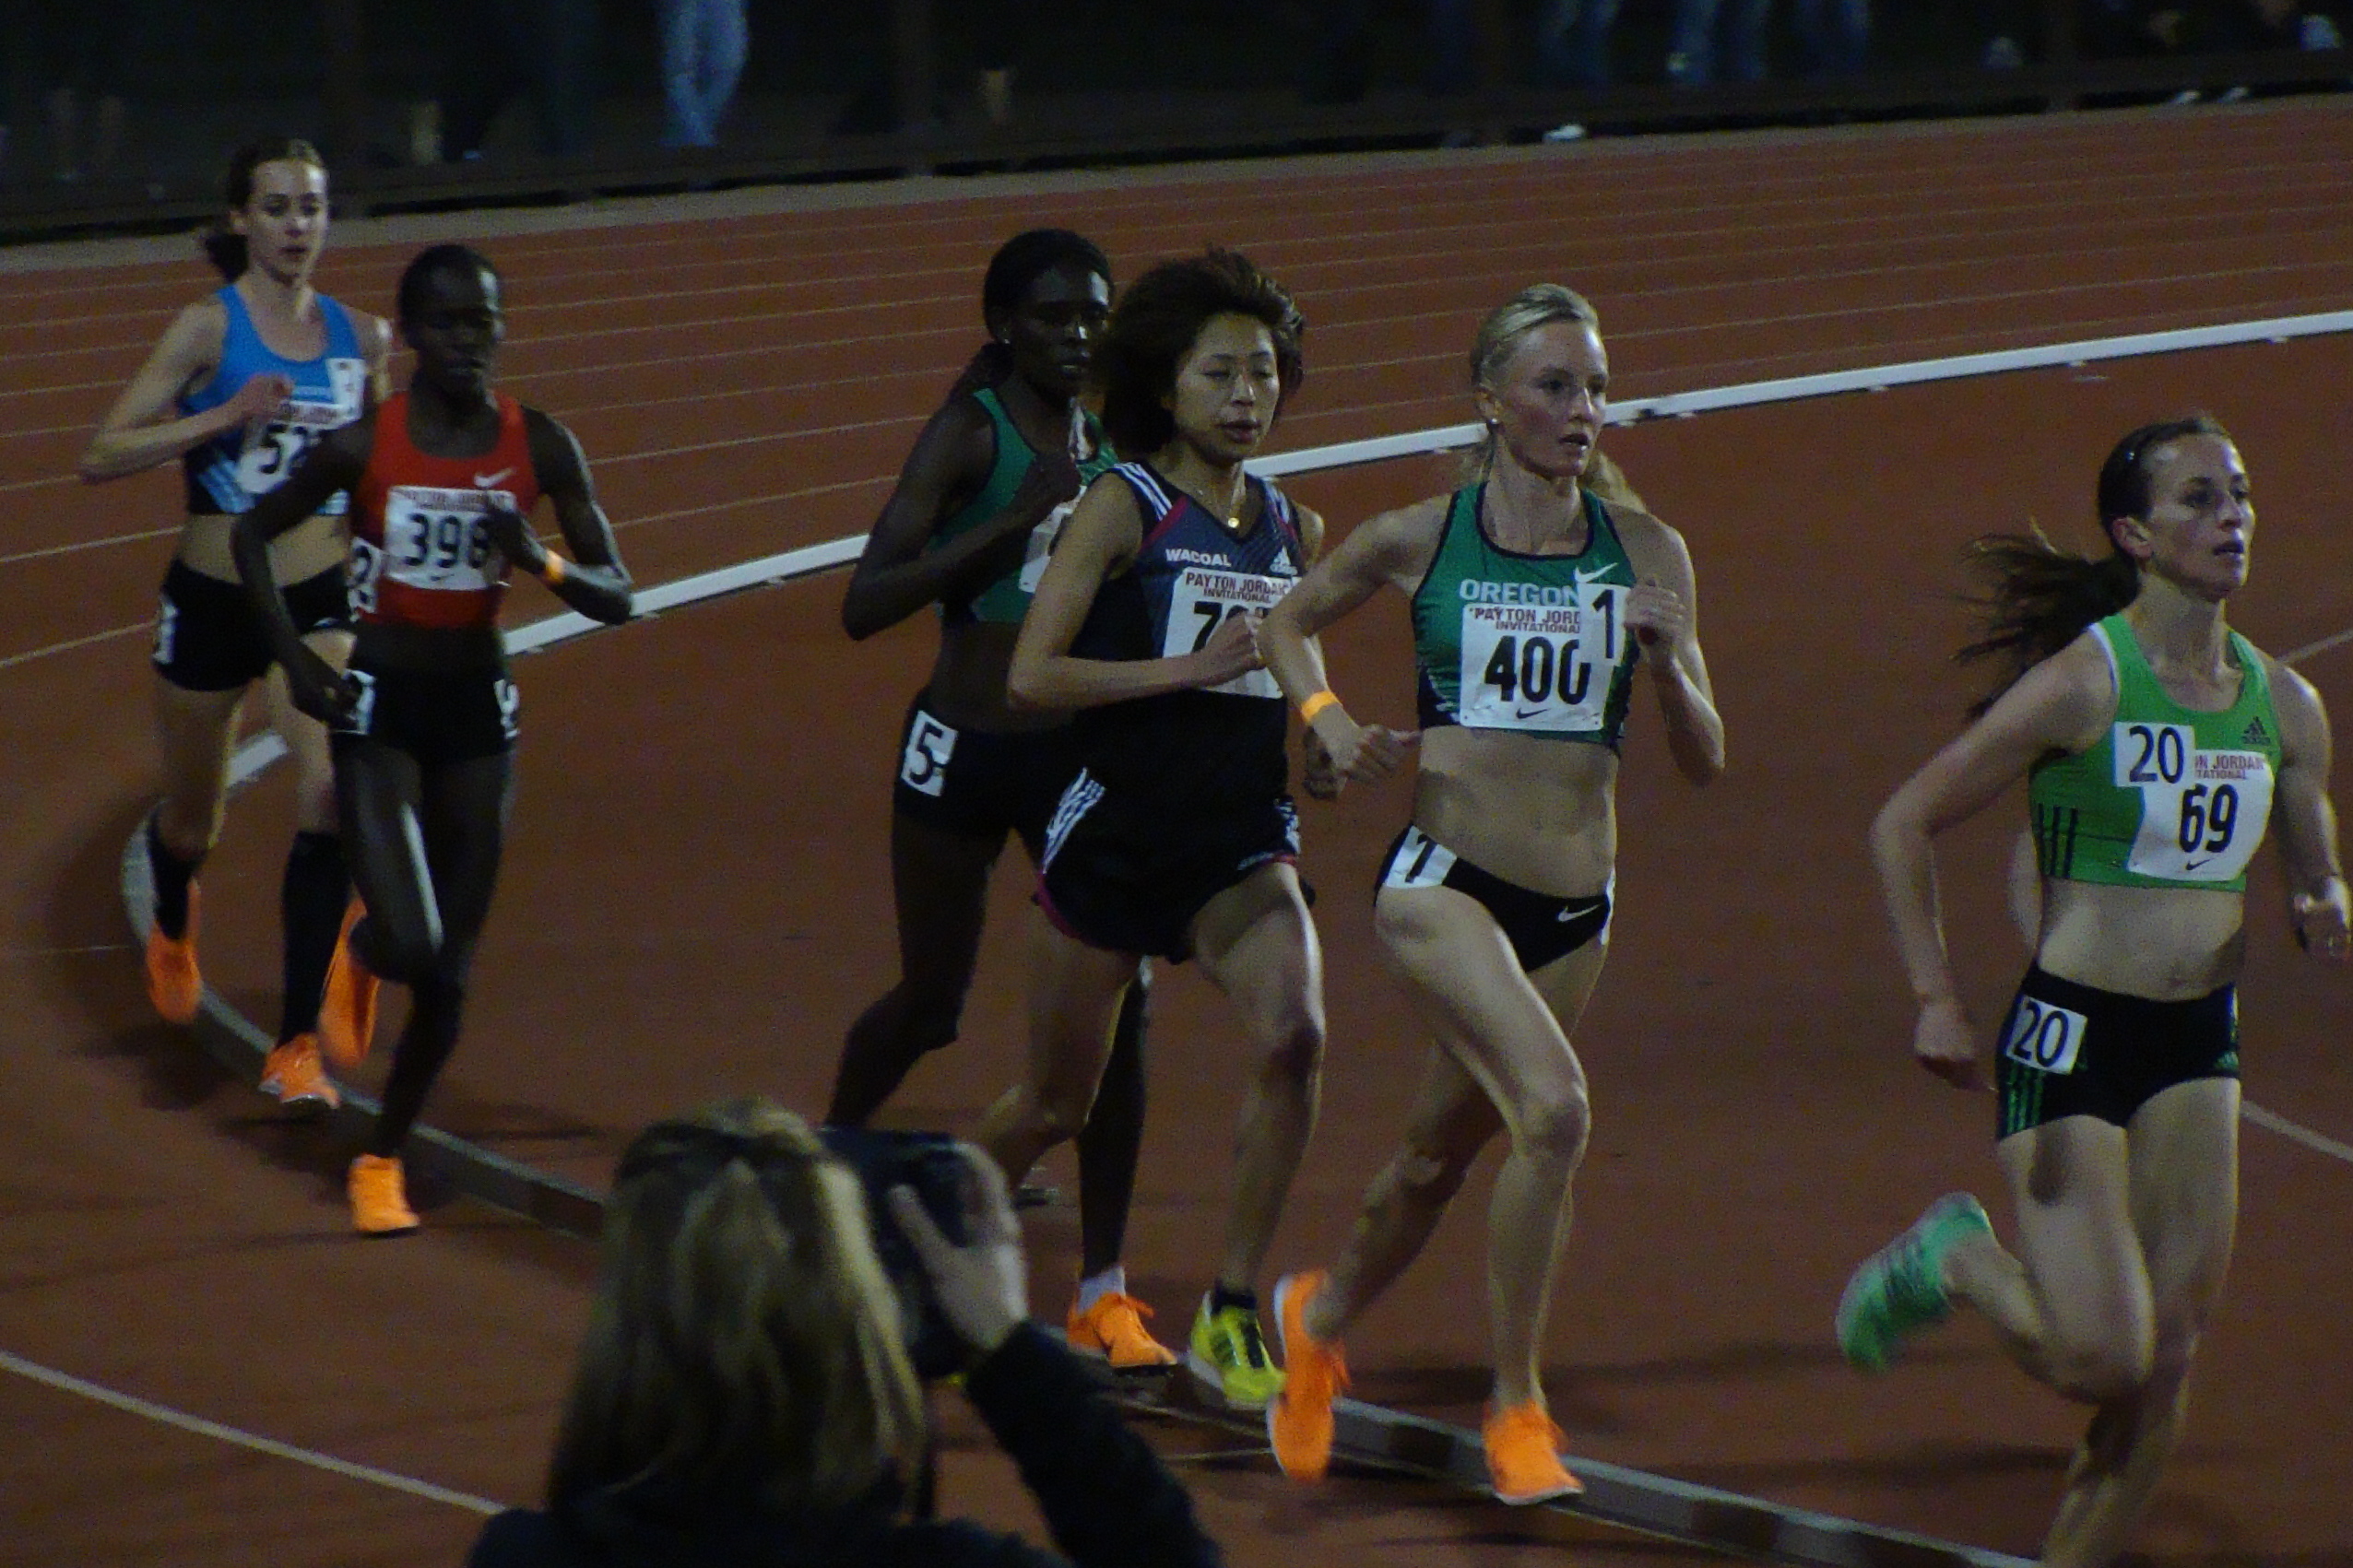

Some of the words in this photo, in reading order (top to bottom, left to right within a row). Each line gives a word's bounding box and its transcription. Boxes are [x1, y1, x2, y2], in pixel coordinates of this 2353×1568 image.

[1165, 548, 1232, 567] WACOAL
[1186, 572, 1236, 590] PAYTON
[1203, 589, 1271, 603] INVITATIONAL
[1460, 579, 1579, 607] OREGON
[1475, 607, 1536, 622] PAYTON
[1542, 610, 1580, 624] JORD
[1592, 589, 1614, 659] 1
[1484, 635, 1591, 705] 400
[908, 721, 943, 785] 5
[2129, 725, 2184, 784] 20
[2179, 784, 2239, 853] 69
[2014, 1000, 2069, 1067] 20
